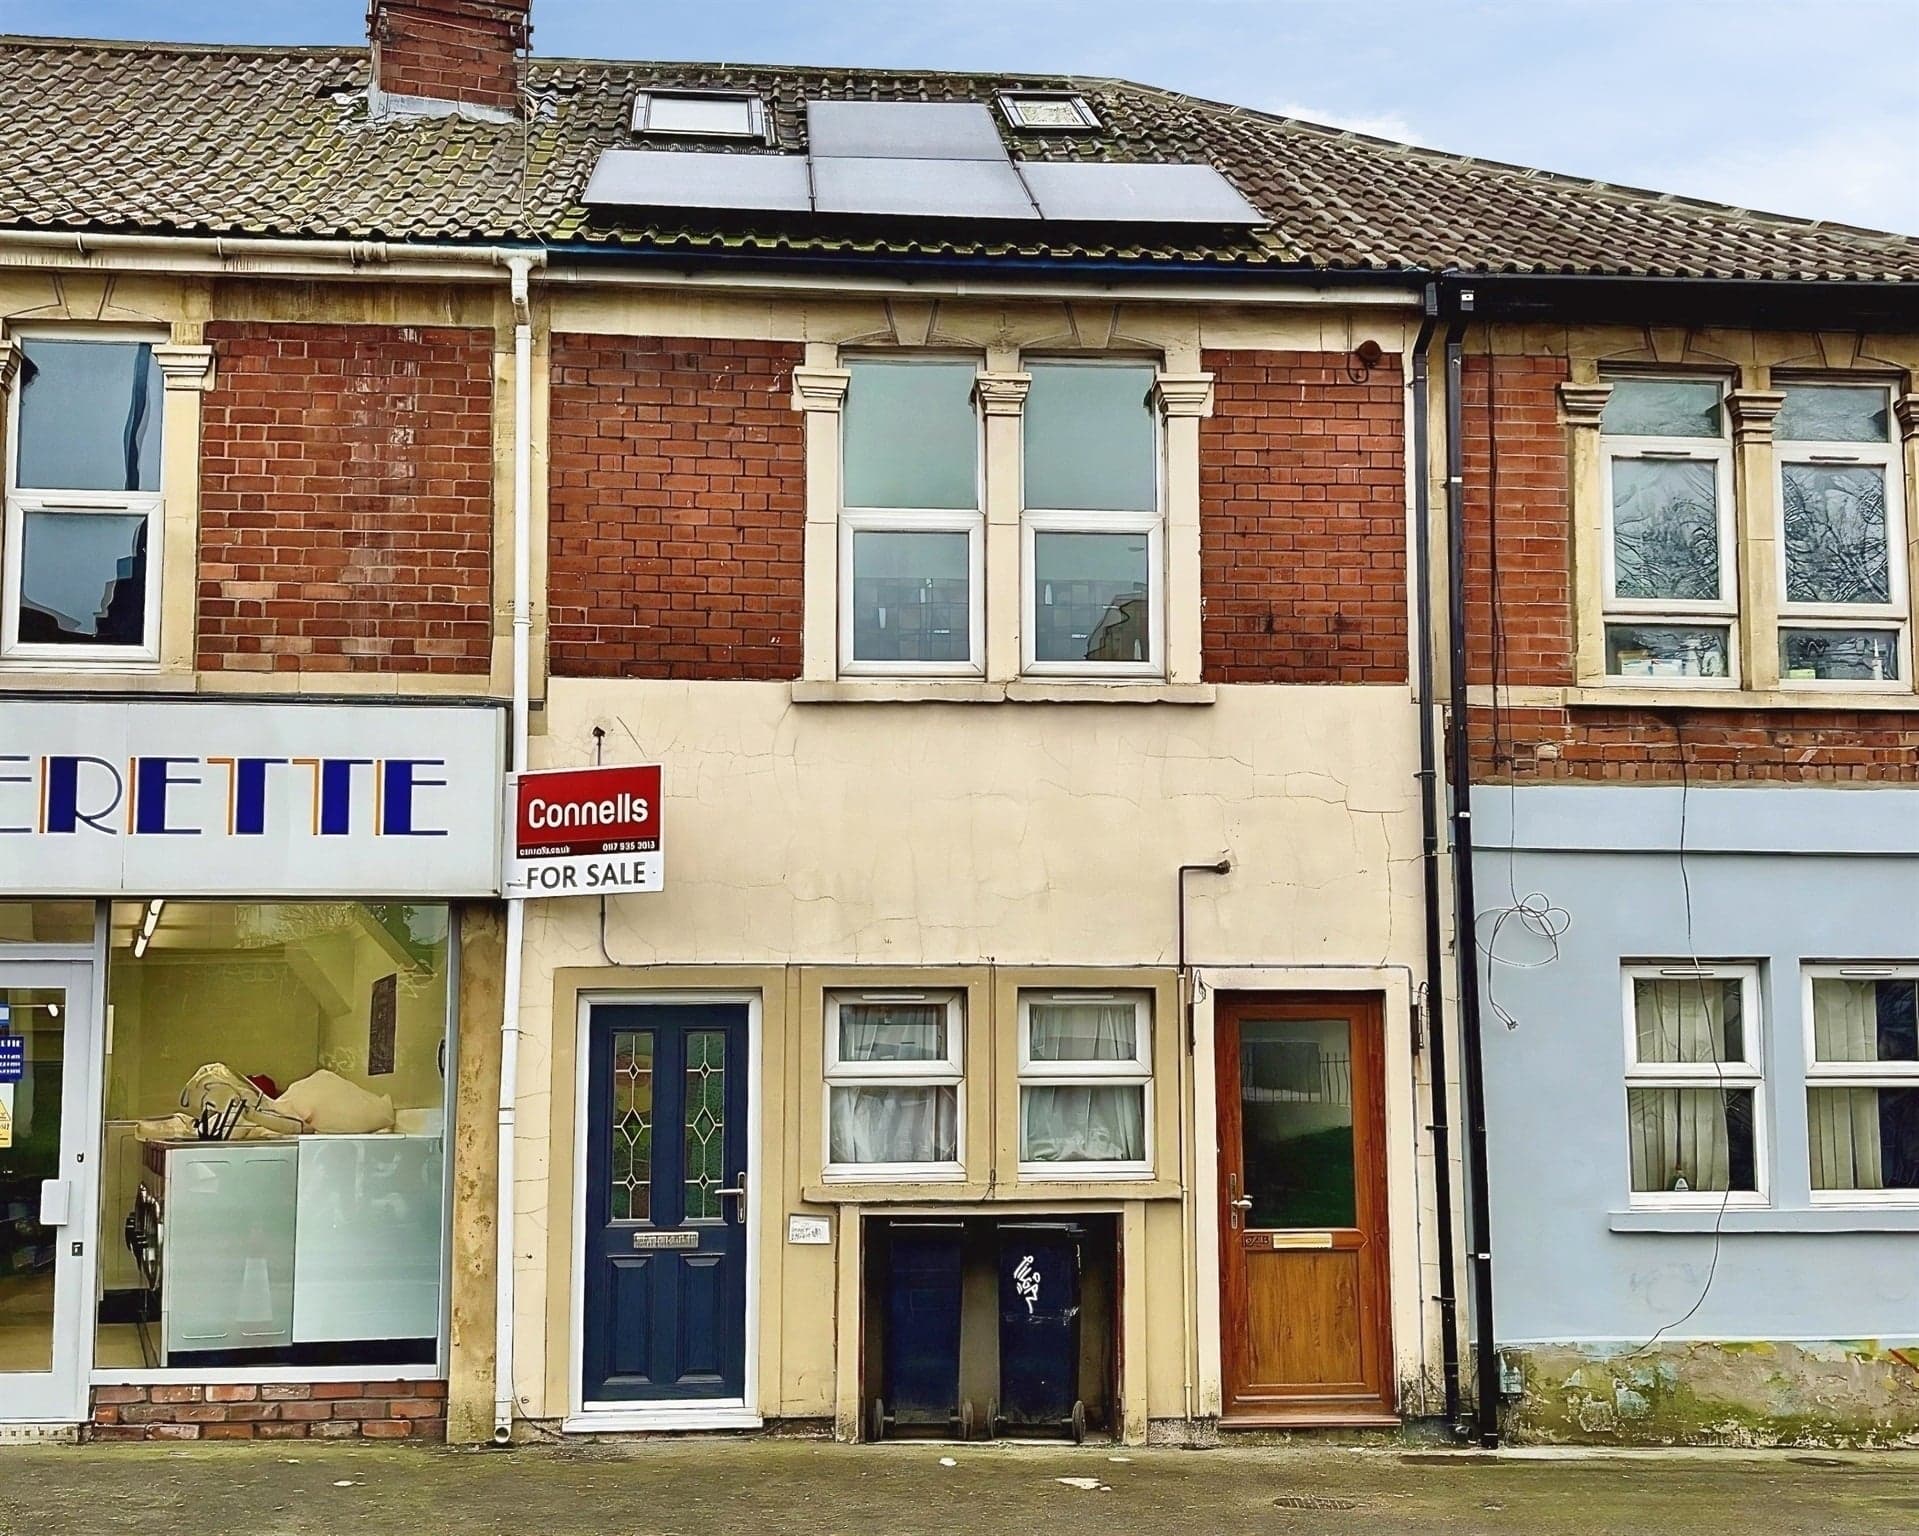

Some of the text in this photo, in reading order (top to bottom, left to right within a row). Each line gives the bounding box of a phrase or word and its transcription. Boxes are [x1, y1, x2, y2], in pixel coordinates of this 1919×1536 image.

[528, 793, 649, 829] Connells
[526, 861, 646, 890] FOR SALE
